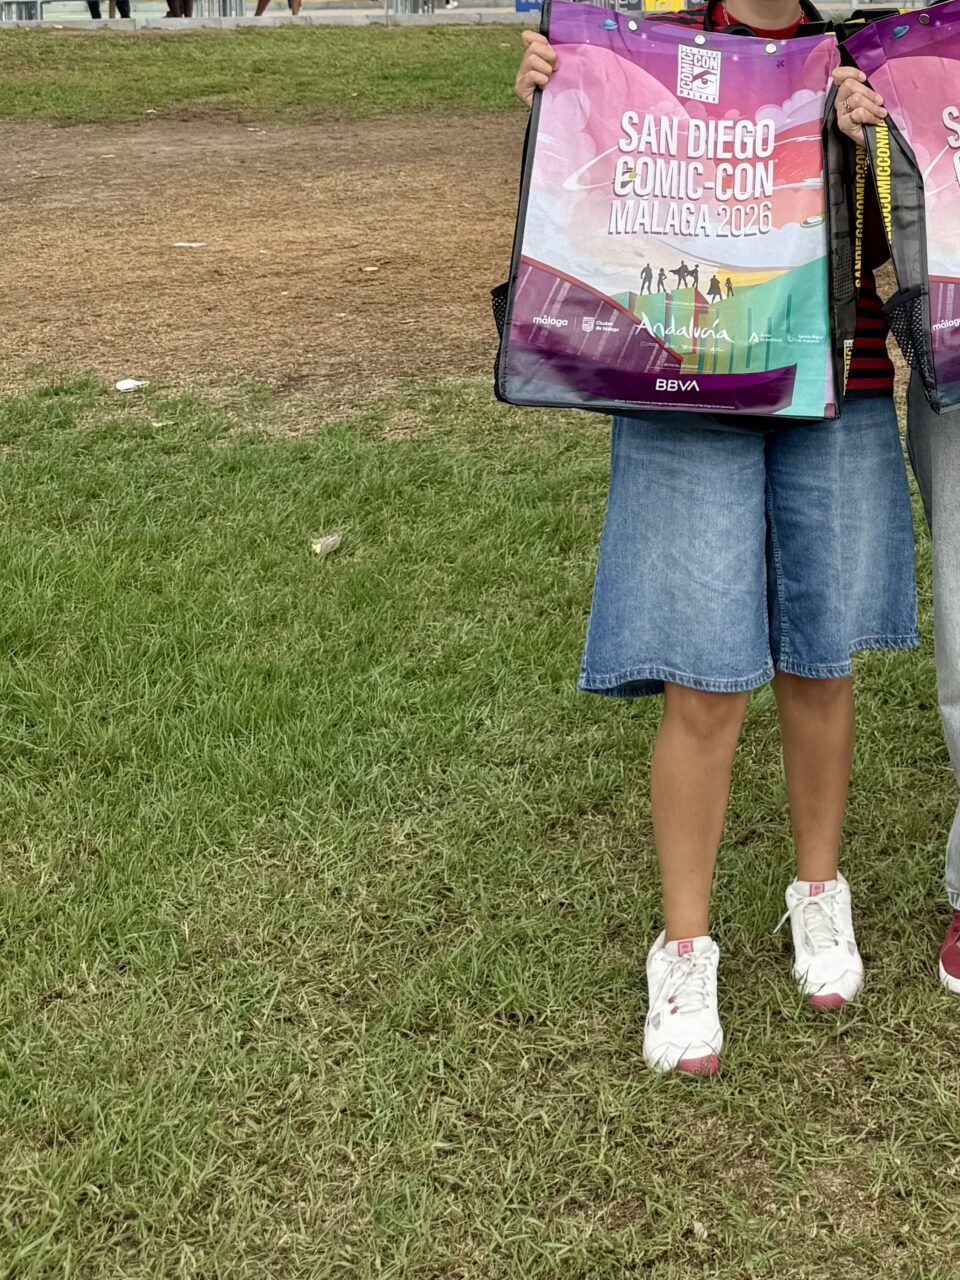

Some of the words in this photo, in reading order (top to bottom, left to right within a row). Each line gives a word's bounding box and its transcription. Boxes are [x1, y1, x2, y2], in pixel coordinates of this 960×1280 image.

[680, 51, 694, 90] COMIC
[693, 54, 718, 70] CON
[618, 110, 679, 157] SAN
[687, 118, 776, 160] DIEGO
[613, 155, 774, 201] COMIC-CON
[608, 197, 710, 237] MÁLAGA
[715, 200, 773, 238] 2026
[532, 315, 569, 328] málaga
[634, 311, 735, 343] Andalucía
[655, 378, 700, 392] BBVA
